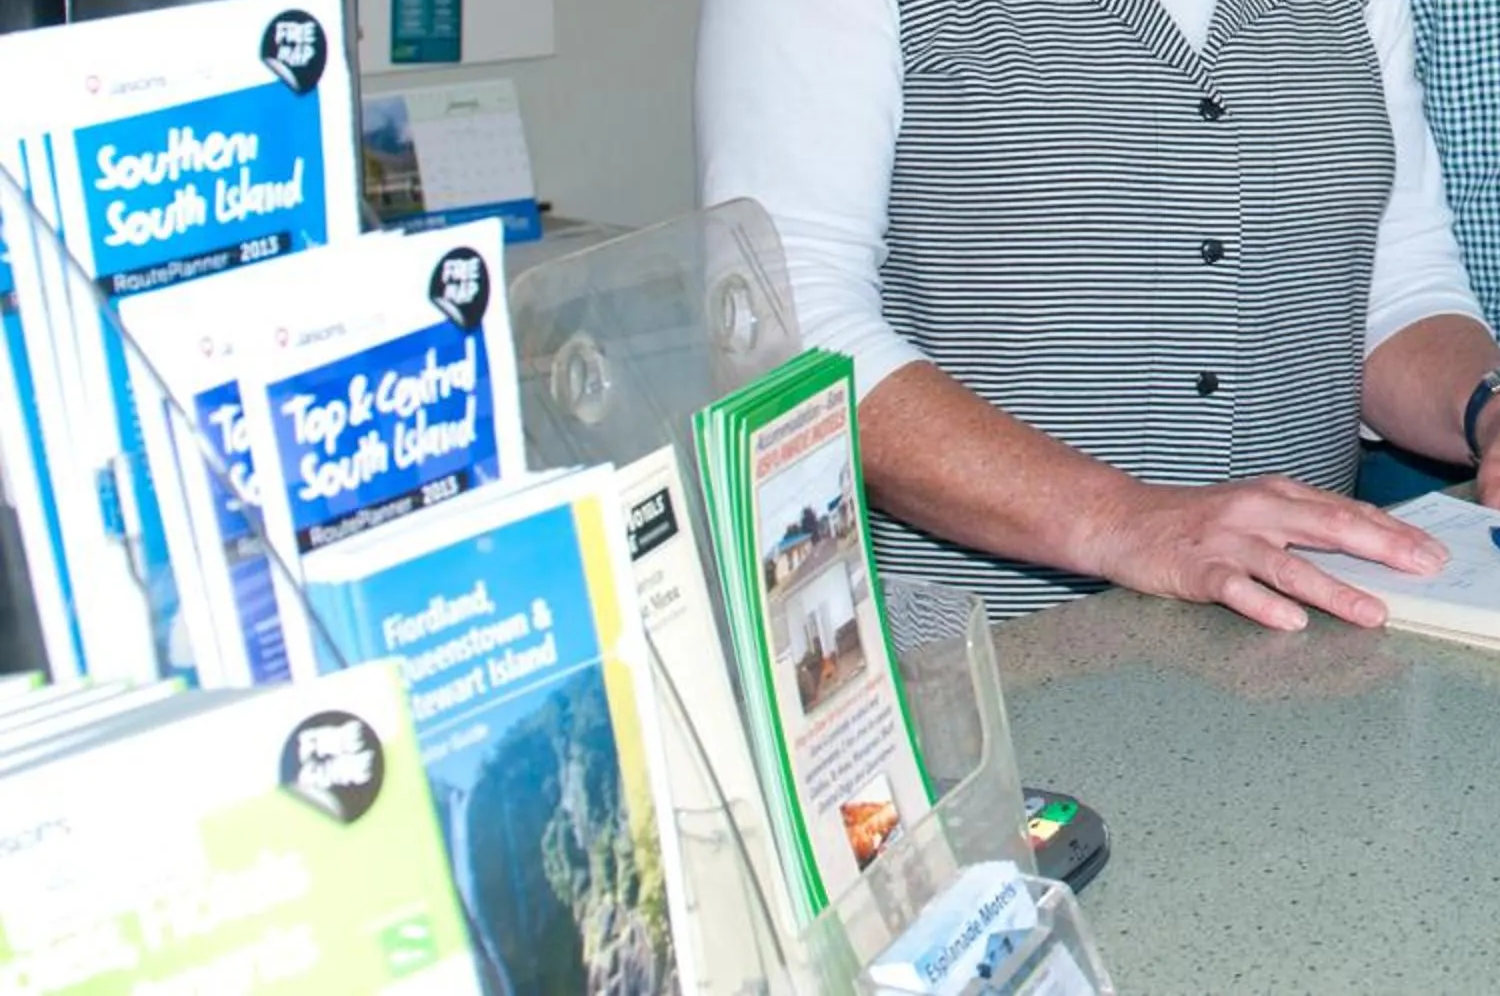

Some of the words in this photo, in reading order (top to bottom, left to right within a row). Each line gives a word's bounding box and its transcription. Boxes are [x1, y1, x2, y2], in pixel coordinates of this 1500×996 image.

[94, 125, 259, 191] Southern
[103, 183, 207, 247] South
[213, 155, 305, 224] Island
[112, 252, 229, 293] RoutePlanner
[239, 234, 280, 262] 2013
[209, 403, 249, 454] To
[281, 393, 347, 456] Top
[348, 374, 375, 427] &
[375, 335, 477, 418] Central
[298, 429, 389, 501] South
[393, 394, 477, 470] Island
[420, 474, 460, 505] 2013
[382, 579, 497, 652] Fiordland,
[531, 597, 554, 631] &
[411, 667, 487, 722] tewart
[486, 631, 559, 688] Island
[924, 919, 982, 984] Esplanade
[977, 881, 1019, 926] Motels
